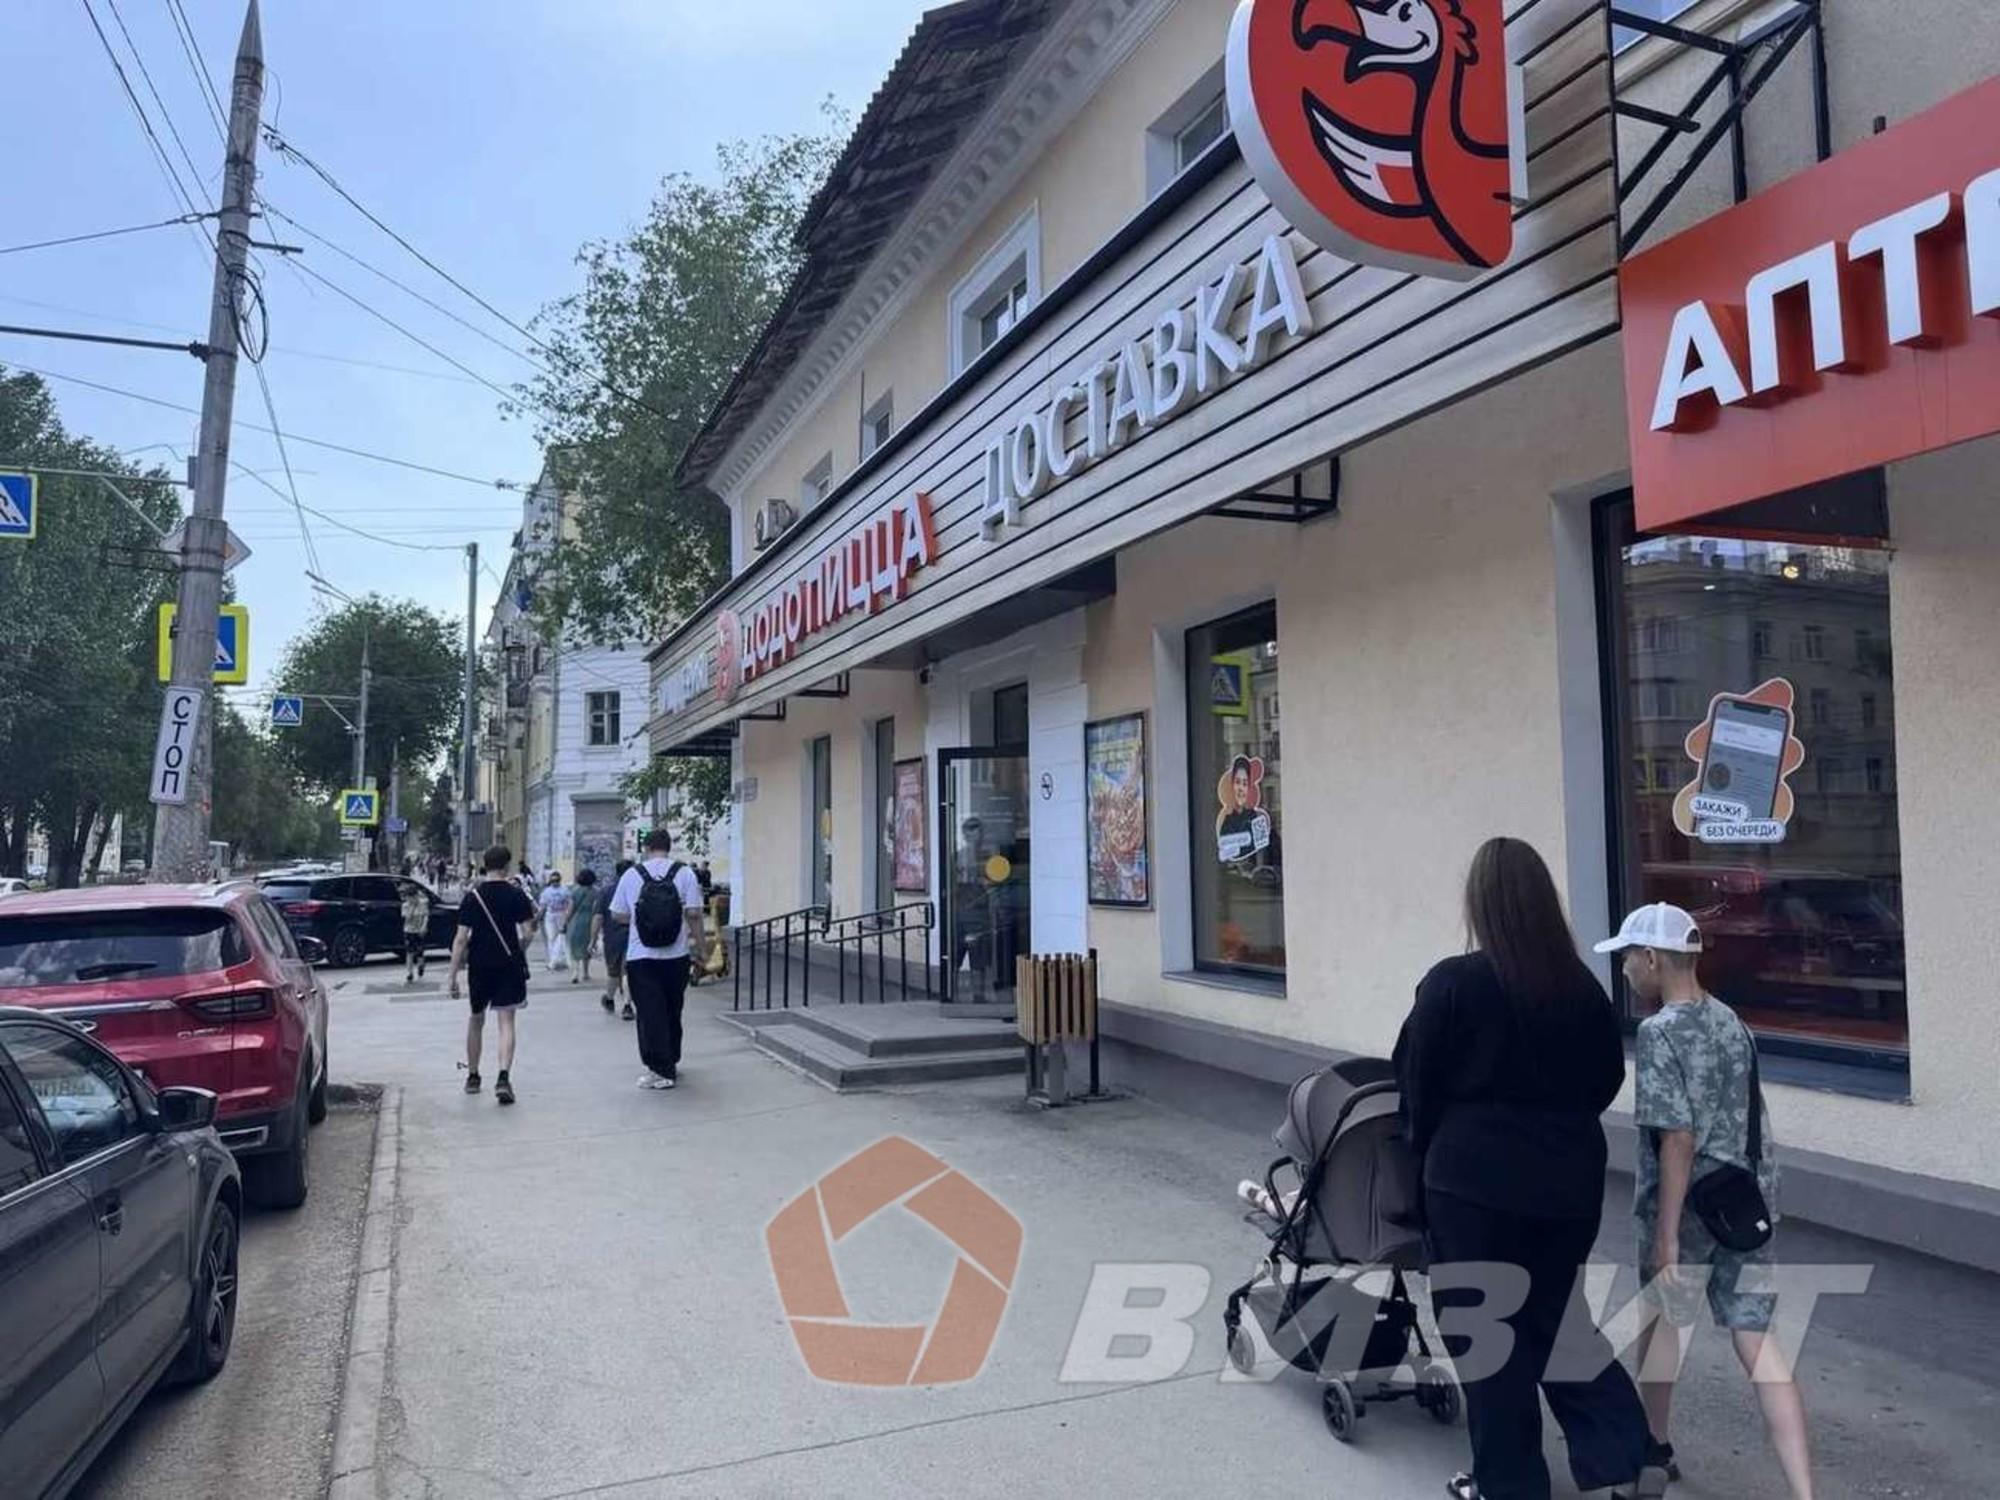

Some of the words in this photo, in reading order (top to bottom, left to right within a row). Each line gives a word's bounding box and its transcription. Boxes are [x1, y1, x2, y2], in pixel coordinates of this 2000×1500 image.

[980, 234, 1313, 541] ДОСТАВКА
[161, 695, 192, 794] СТОП
[1695, 799, 1742, 816] ЗАКАЖИ
[1706, 826, 1725, 837] БЕЗ
[1726, 825, 1777, 837] ОЧЕРЕДИ
